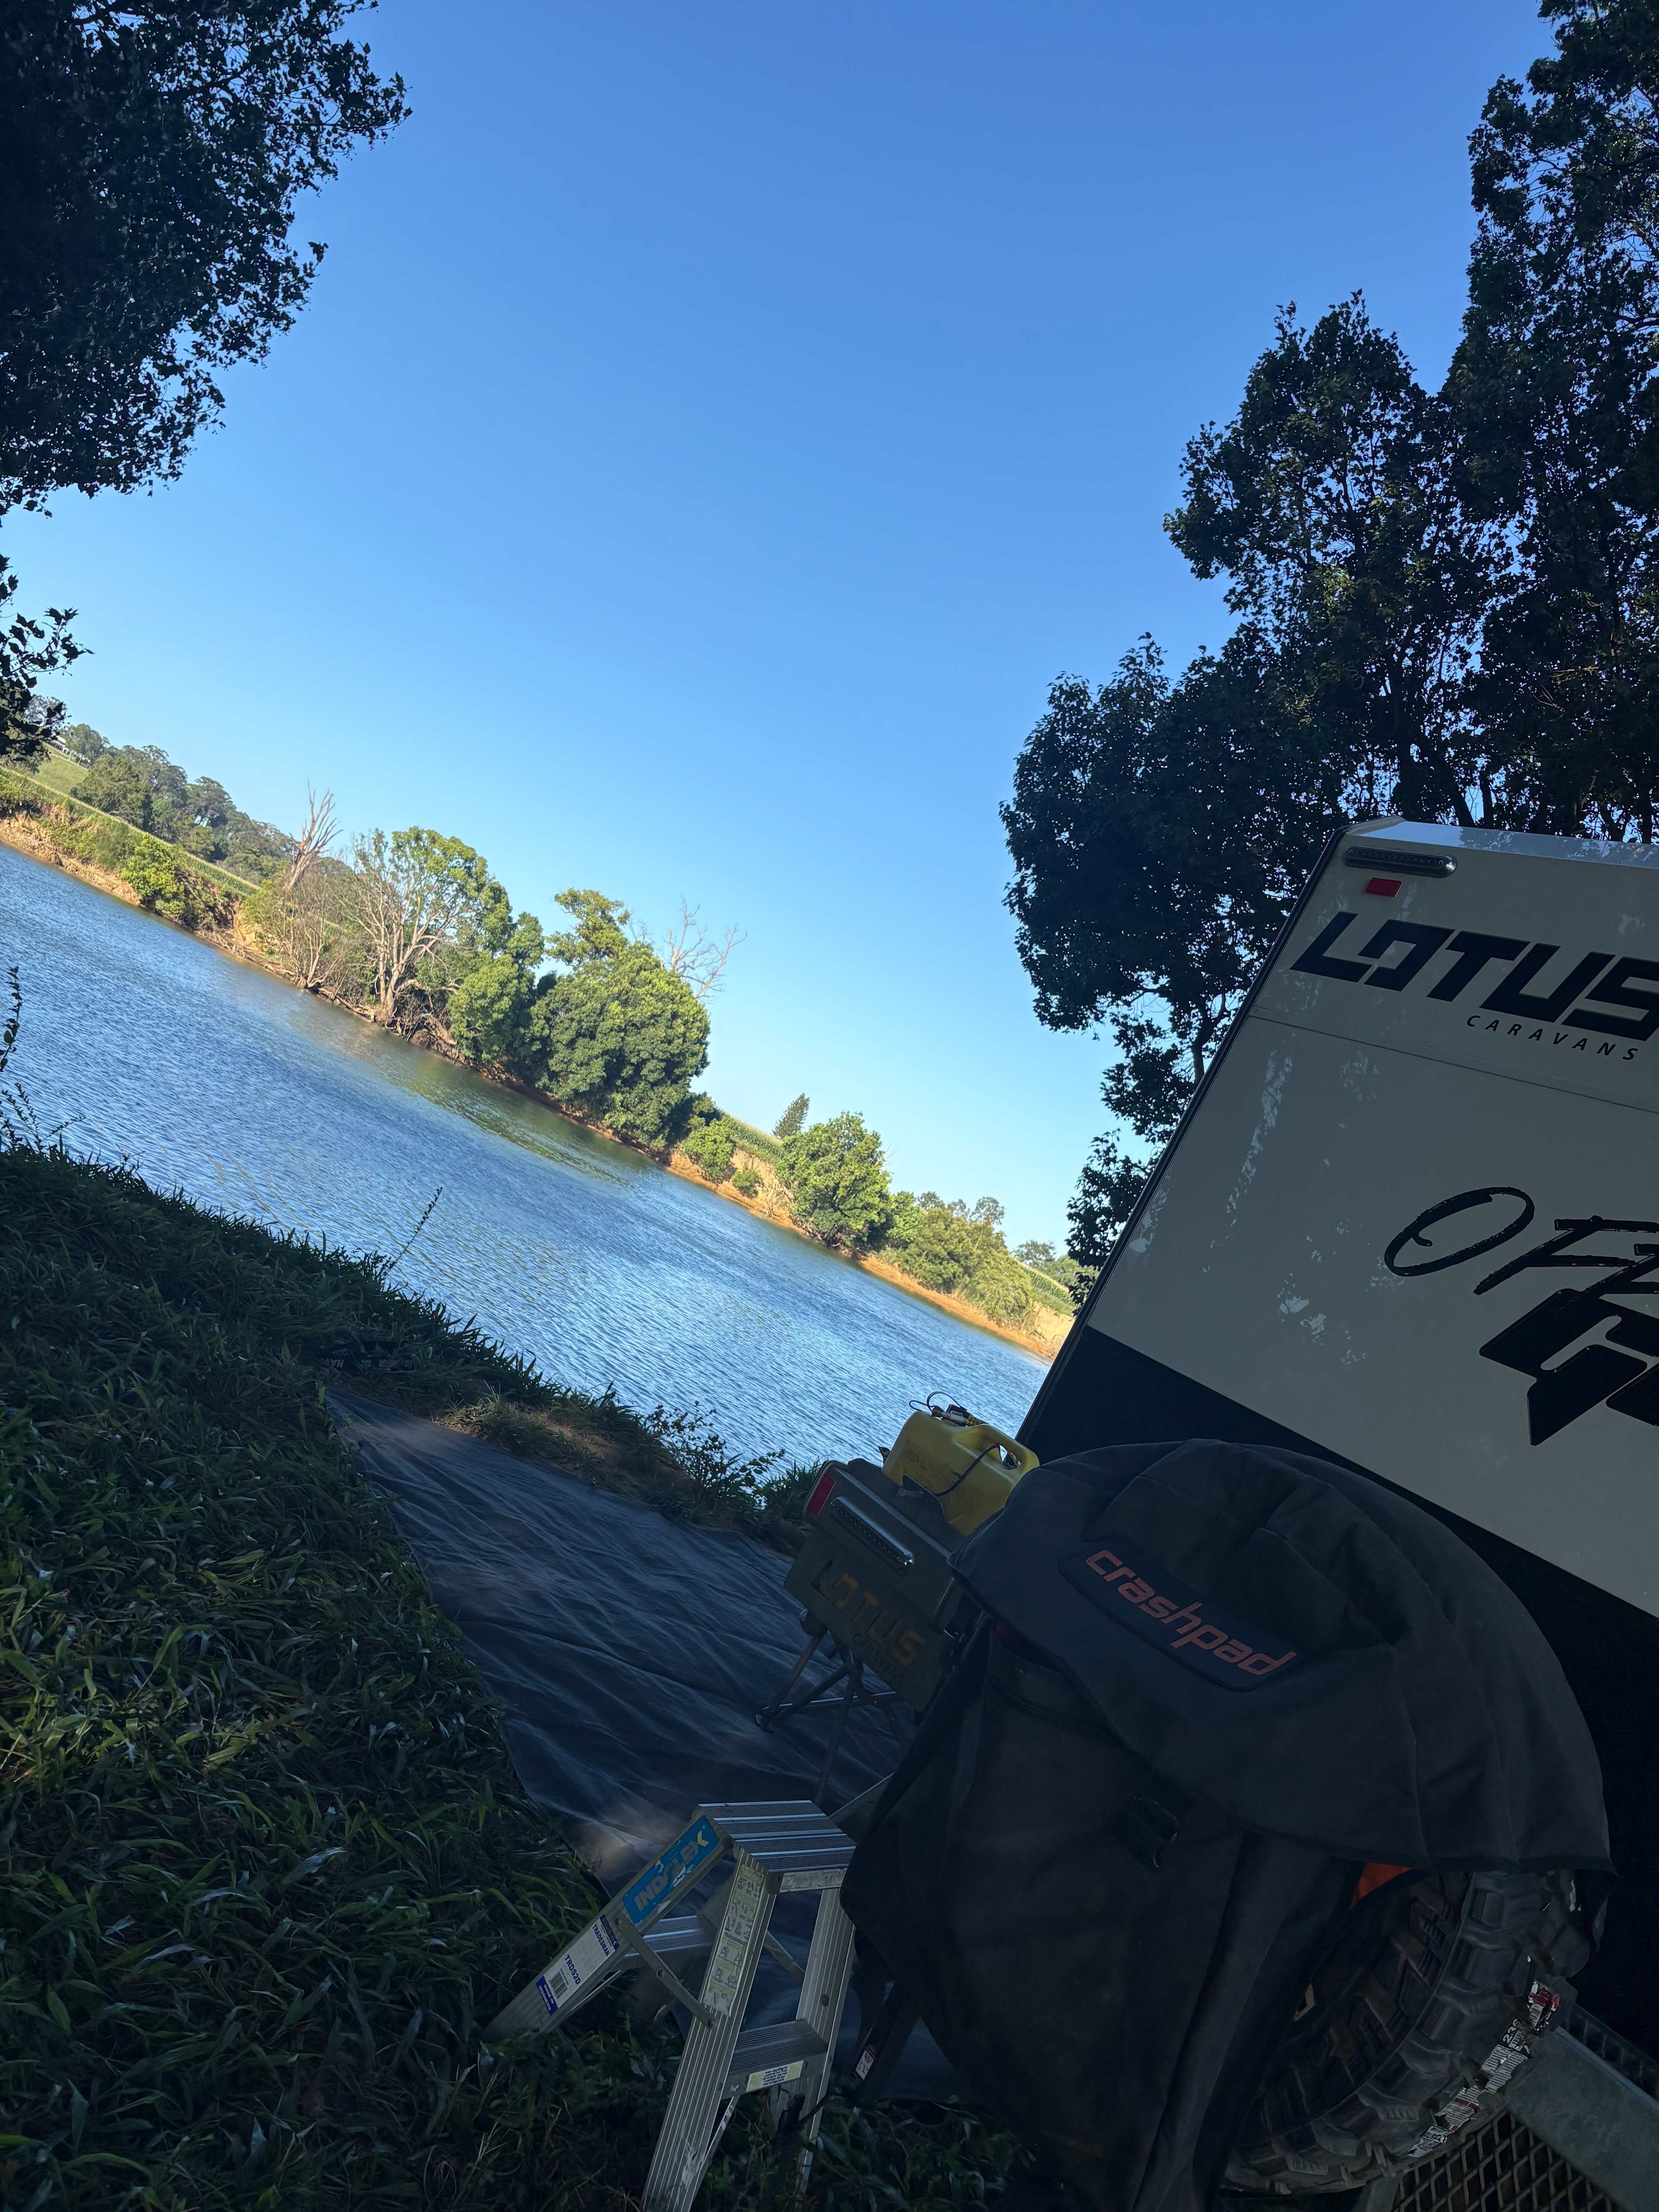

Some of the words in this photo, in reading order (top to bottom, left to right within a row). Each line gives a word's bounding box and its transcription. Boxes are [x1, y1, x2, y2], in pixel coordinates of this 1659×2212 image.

[1290, 912, 1659, 1041] LOTUS
[1467, 1015, 1639, 1060] CARAVANS
[811, 1559, 925, 1669] LOTUS
[1085, 1550, 1297, 1675] crashpad
[592, 1923, 610, 1957] TRADESMAN
[564, 1954, 581, 1985] TRDS2D
[538, 1985, 552, 2011] INDONESIA
[544, 1984, 552, 1998] MADE
[549, 1996, 555, 2005] IN
